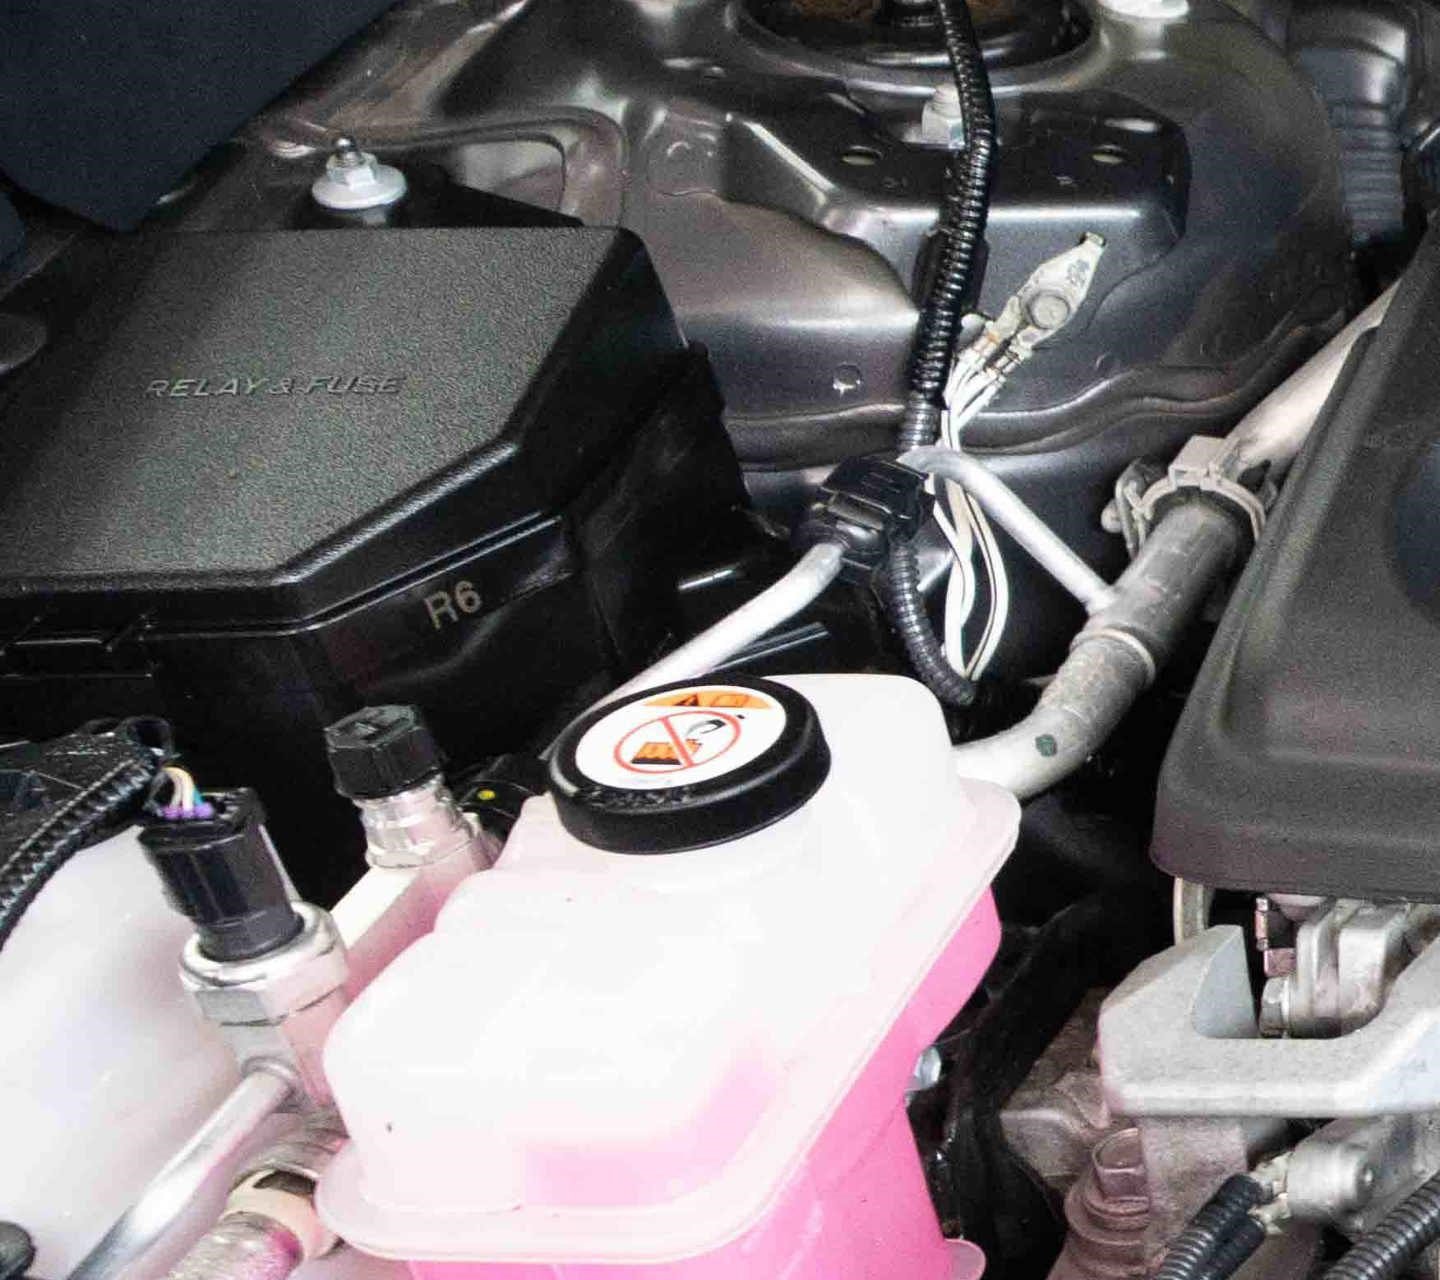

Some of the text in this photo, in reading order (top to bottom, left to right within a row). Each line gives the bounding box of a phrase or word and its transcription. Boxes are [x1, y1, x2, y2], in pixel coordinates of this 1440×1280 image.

[147, 377, 269, 397] RELAY
[305, 376, 405, 394] FUSE
[424, 581, 482, 629] R6
